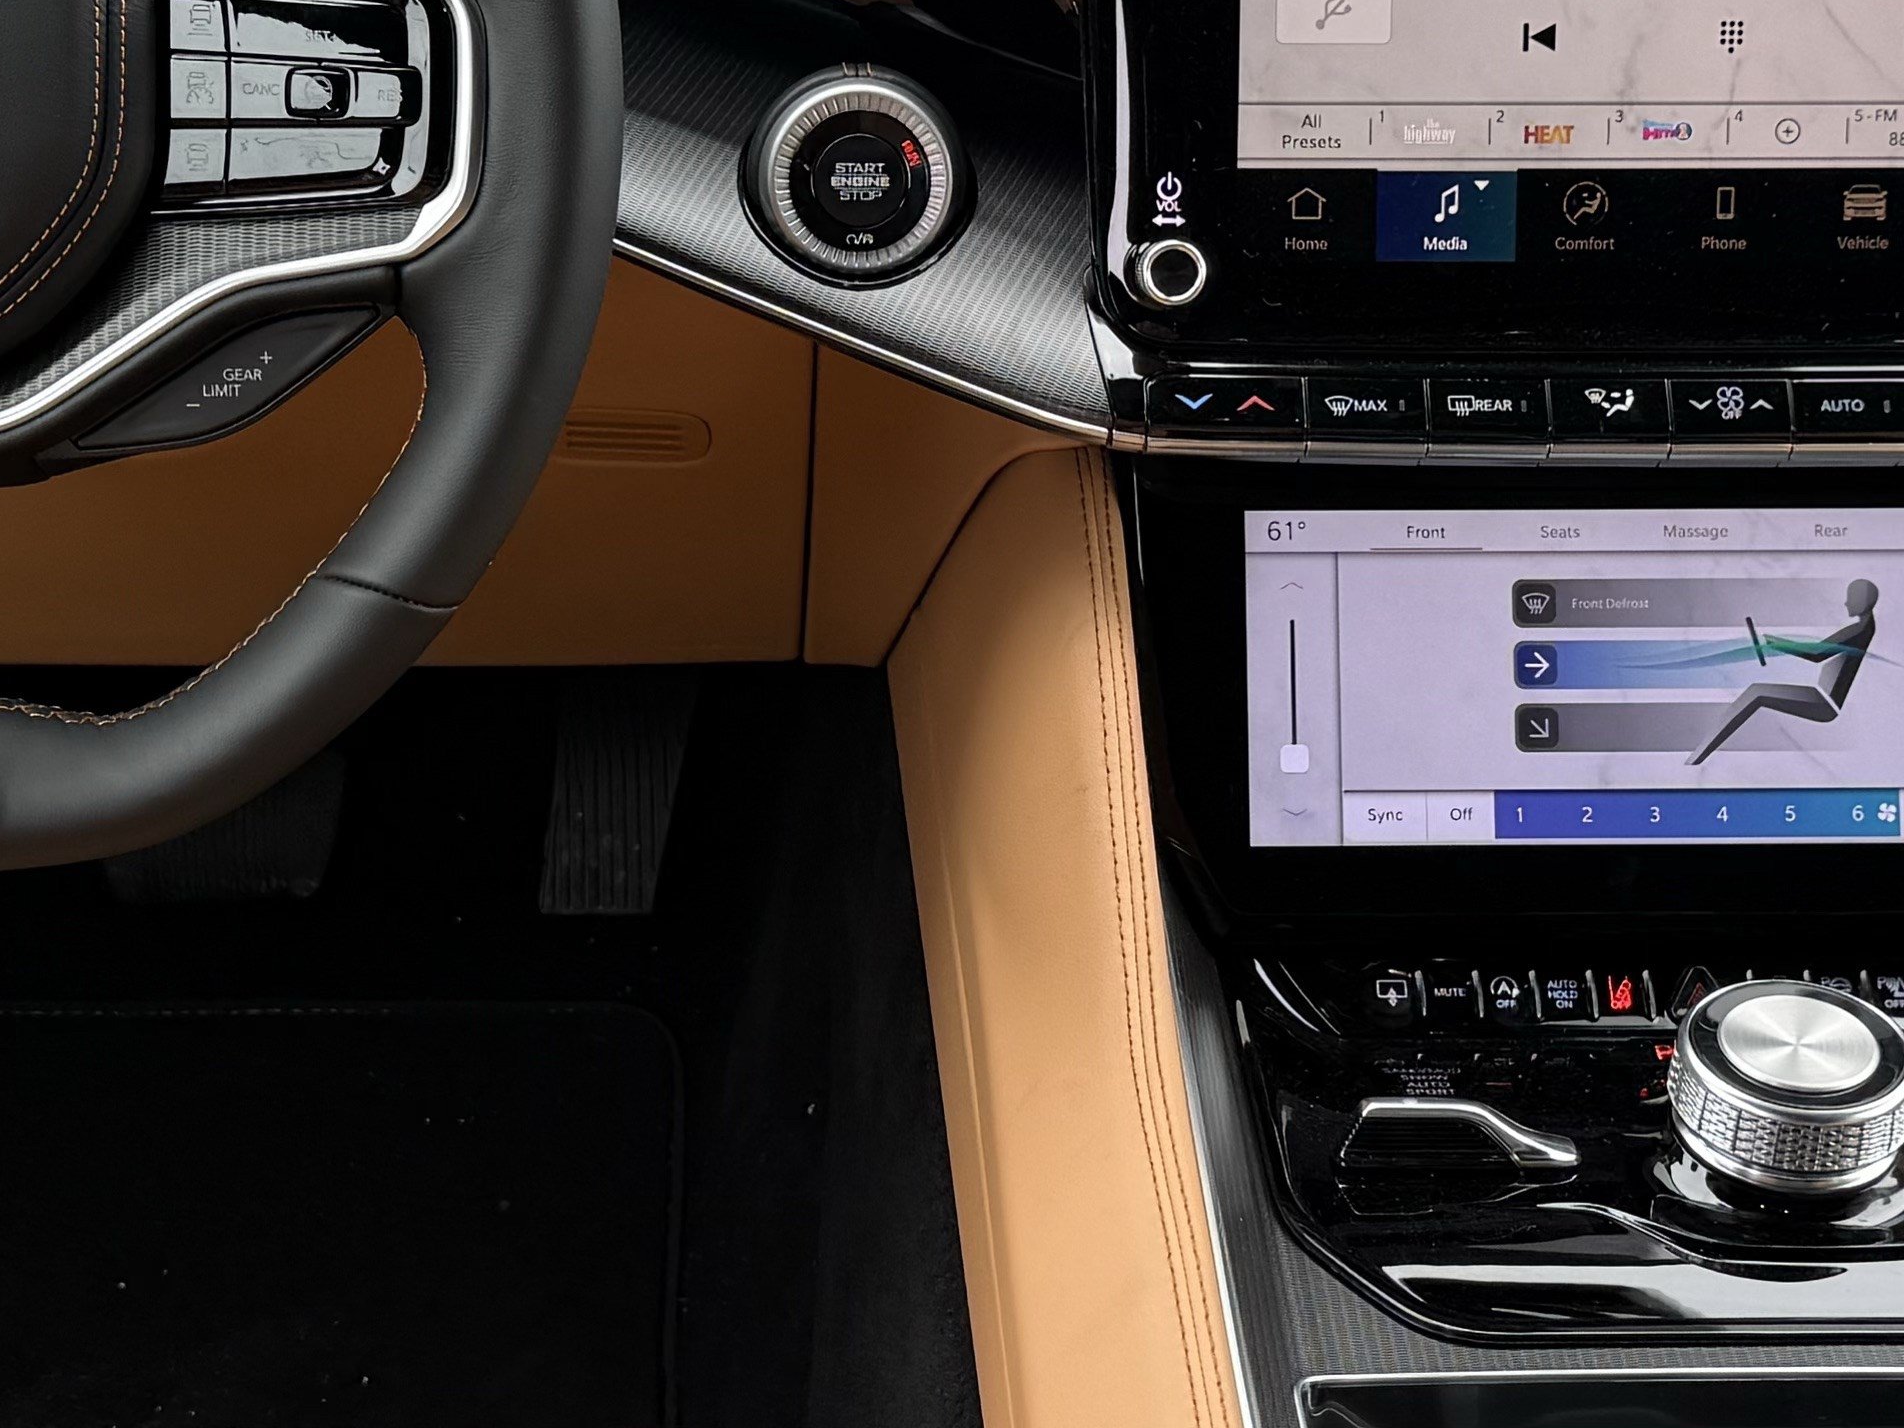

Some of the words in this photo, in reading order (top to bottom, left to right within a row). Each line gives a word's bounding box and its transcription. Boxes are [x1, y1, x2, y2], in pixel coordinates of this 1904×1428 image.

[241, 82, 281, 97] CANC
[1300, 114, 1322, 130] All
[1377, 110, 1385, 123] 1
[1495, 110, 1505, 123] 2
[1614, 110, 1624, 123] 3
[1281, 133, 1342, 151] Presets
[1523, 124, 1575, 145] HEAT
[835, 162, 886, 174] START
[830, 175, 891, 187] ENGINE
[839, 188, 883, 202] STOP
[1155, 199, 1183, 213] VOL
[1284, 236, 1329, 252] Home
[1422, 236, 1469, 252] Media
[1554, 235, 1616, 252] Comfort
[1700, 236, 1748, 252] Phone
[1836, 234, 1889, 252] Vehicle
[222, 367, 264, 383] GEAR
[201, 383, 242, 399] LIMIT
[1353, 398, 1388, 413] MAX
[1473, 398, 1513, 413] REAR
[1819, 398, 1865, 413] AUTO
[1267, 519, 1307, 542] 61°
[1406, 525, 1446, 540] Front
[1540, 524, 1581, 540] Seats
[1662, 524, 1729, 542] Massage
[1814, 523, 1849, 539] Rear
[1571, 597, 1604, 611] Front
[1366, 807, 1404, 824] Sync
[1449, 806, 1474, 822] Off
[1516, 807, 1524, 823] 1
[1581, 807, 1594, 823] 2
[1650, 807, 1661, 823] 3
[1716, 806, 1729, 822] 4
[1784, 806, 1796, 822] 5
[1852, 806, 1865, 822] 6
[1433, 987, 1467, 998] MUTE
[1546, 979, 1578, 990] AUTO
[1547, 989, 1578, 1000] HOLD
[1496, 999, 1518, 1009] OFF
[1555, 999, 1574, 1009] ON
